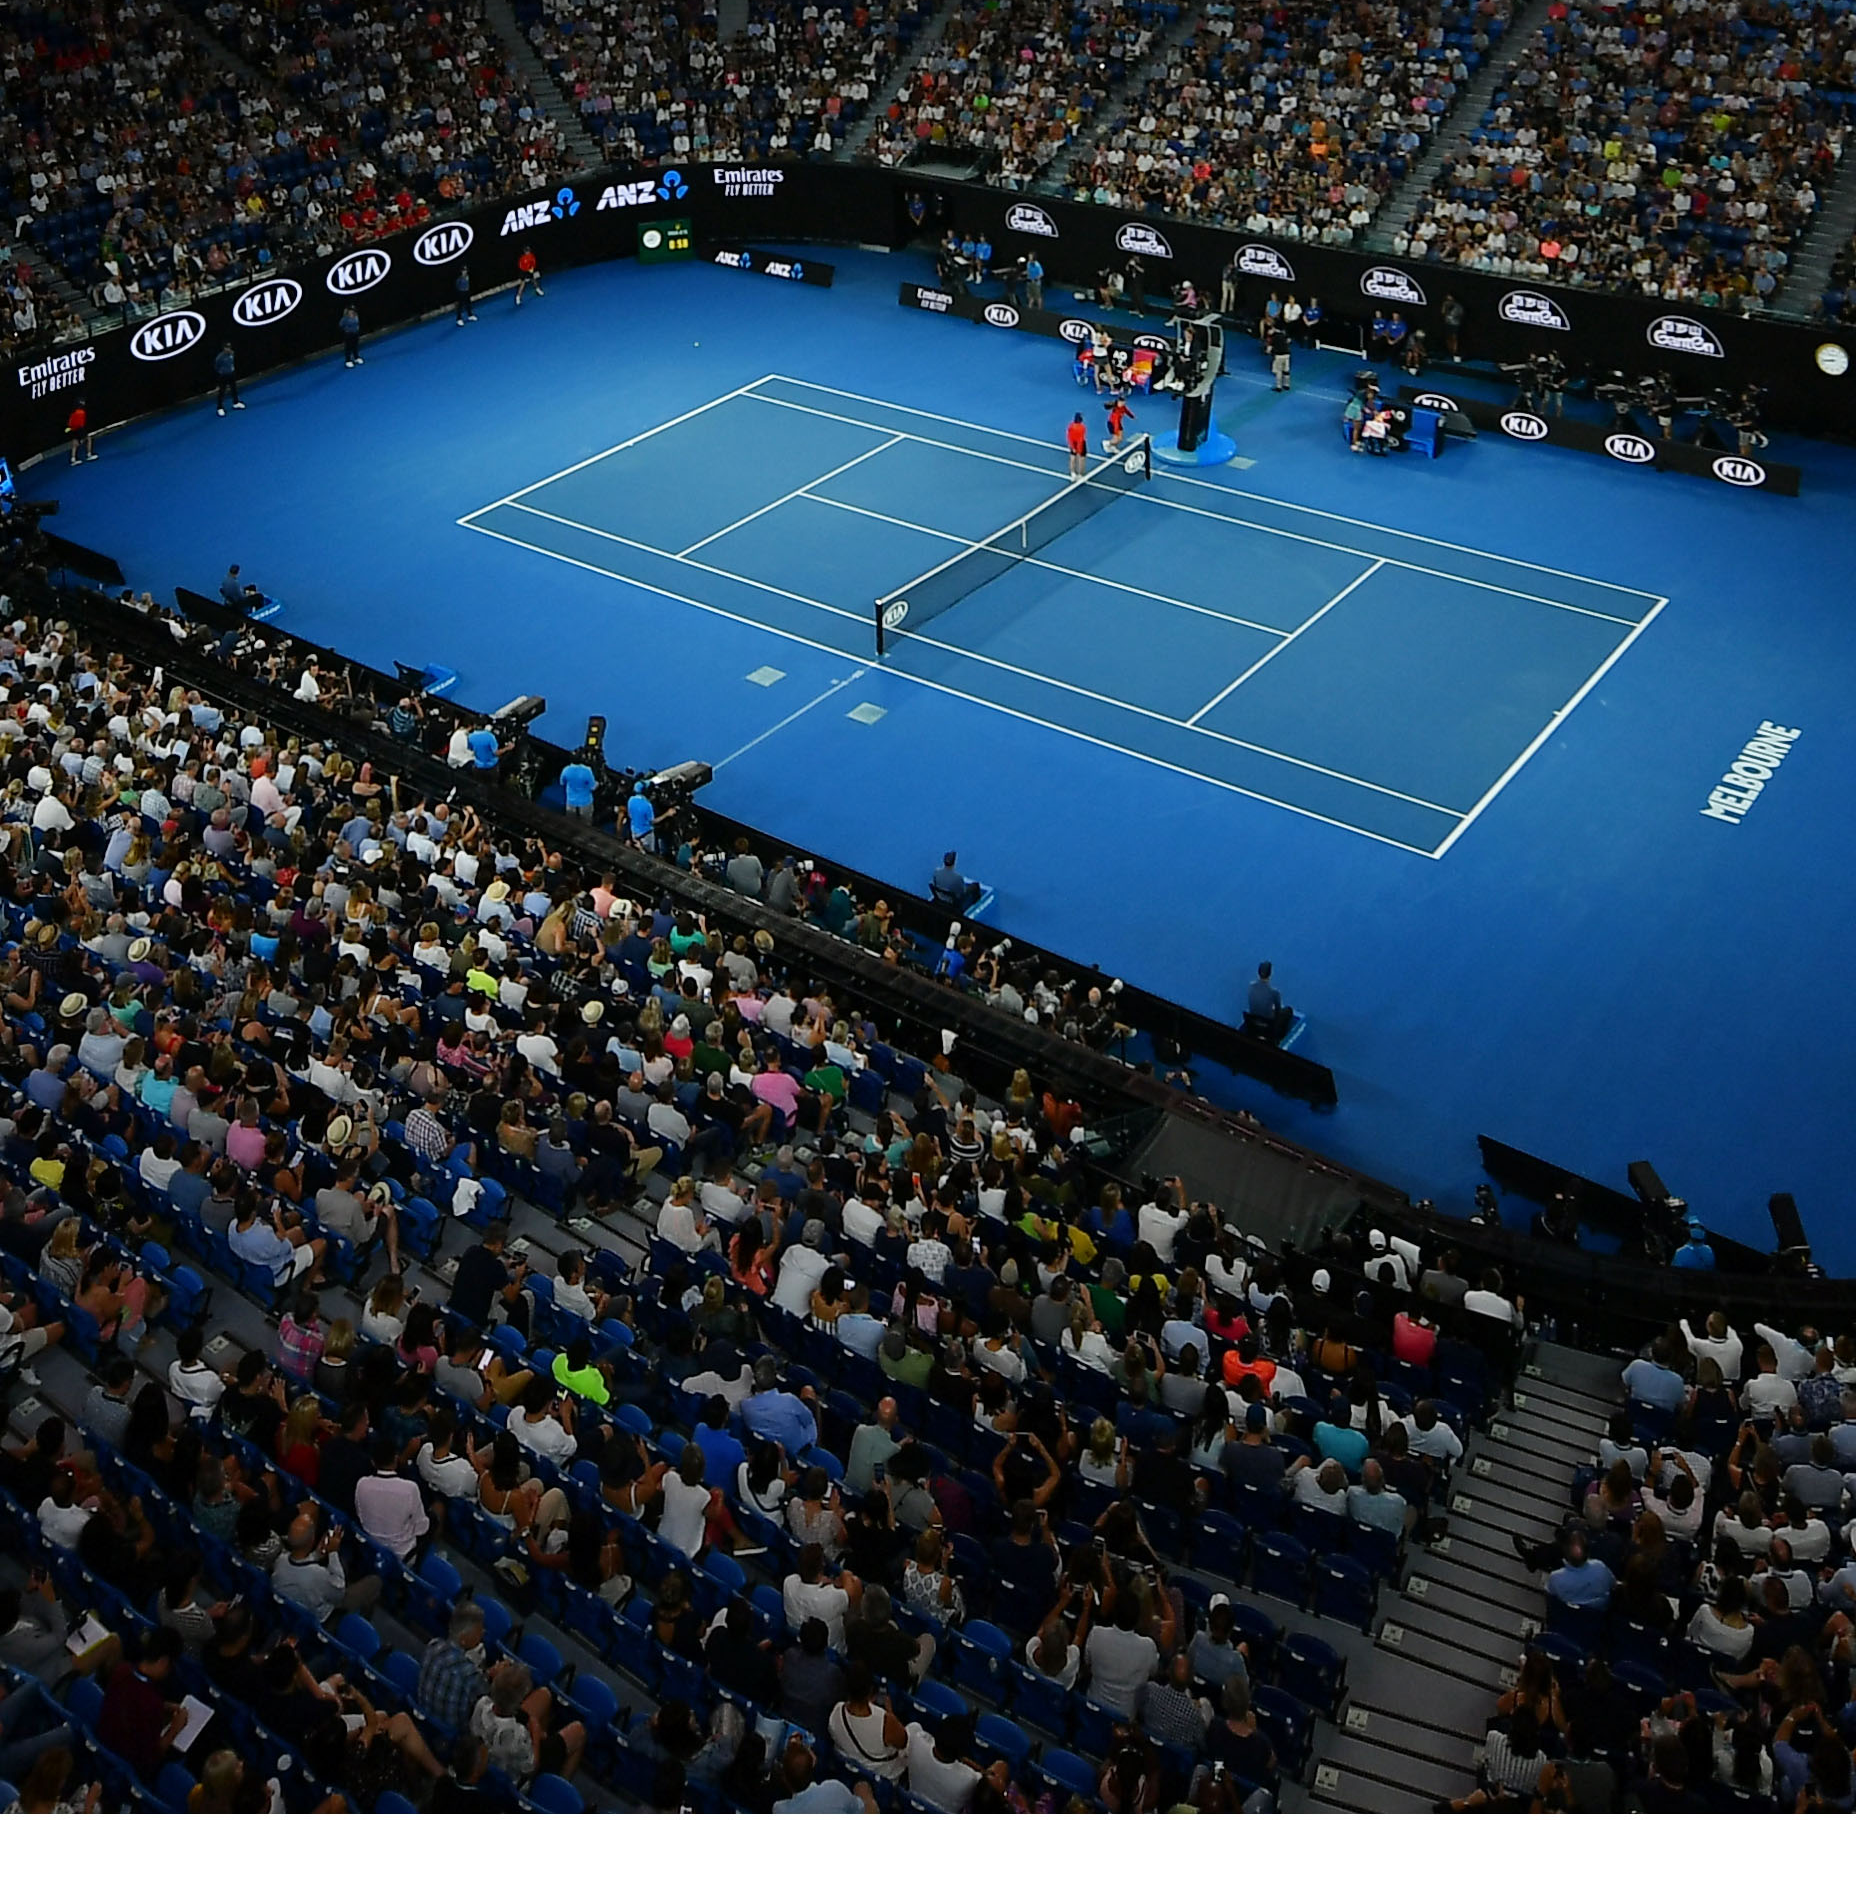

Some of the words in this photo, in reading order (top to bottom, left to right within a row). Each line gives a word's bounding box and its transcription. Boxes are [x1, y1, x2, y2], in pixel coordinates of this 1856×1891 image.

[713, 166, 784, 184] Emirates
[725, 184, 741, 196] FLY
[742, 183, 775, 196] BETTER
[596, 180, 657, 211] ANZ
[500, 199, 552, 236] ANZ
[423, 228, 465, 260] KIA
[715, 251, 741, 267] ANZ
[337, 256, 381, 289] KIA
[765, 262, 792, 278] ANZ
[244, 286, 292, 320] KIA
[917, 288, 952, 305] Emirates
[143, 318, 195, 354] KIA
[18, 346, 96, 387] Emirates
[31, 380, 47, 399] FLY
[48, 366, 86, 392] BETTER
[1508, 417, 1540, 436] KIA
[1612, 438, 1647, 459] KIA
[1721, 461, 1756, 482] KIA
[1699, 719, 1803, 825] MELBOURNE
